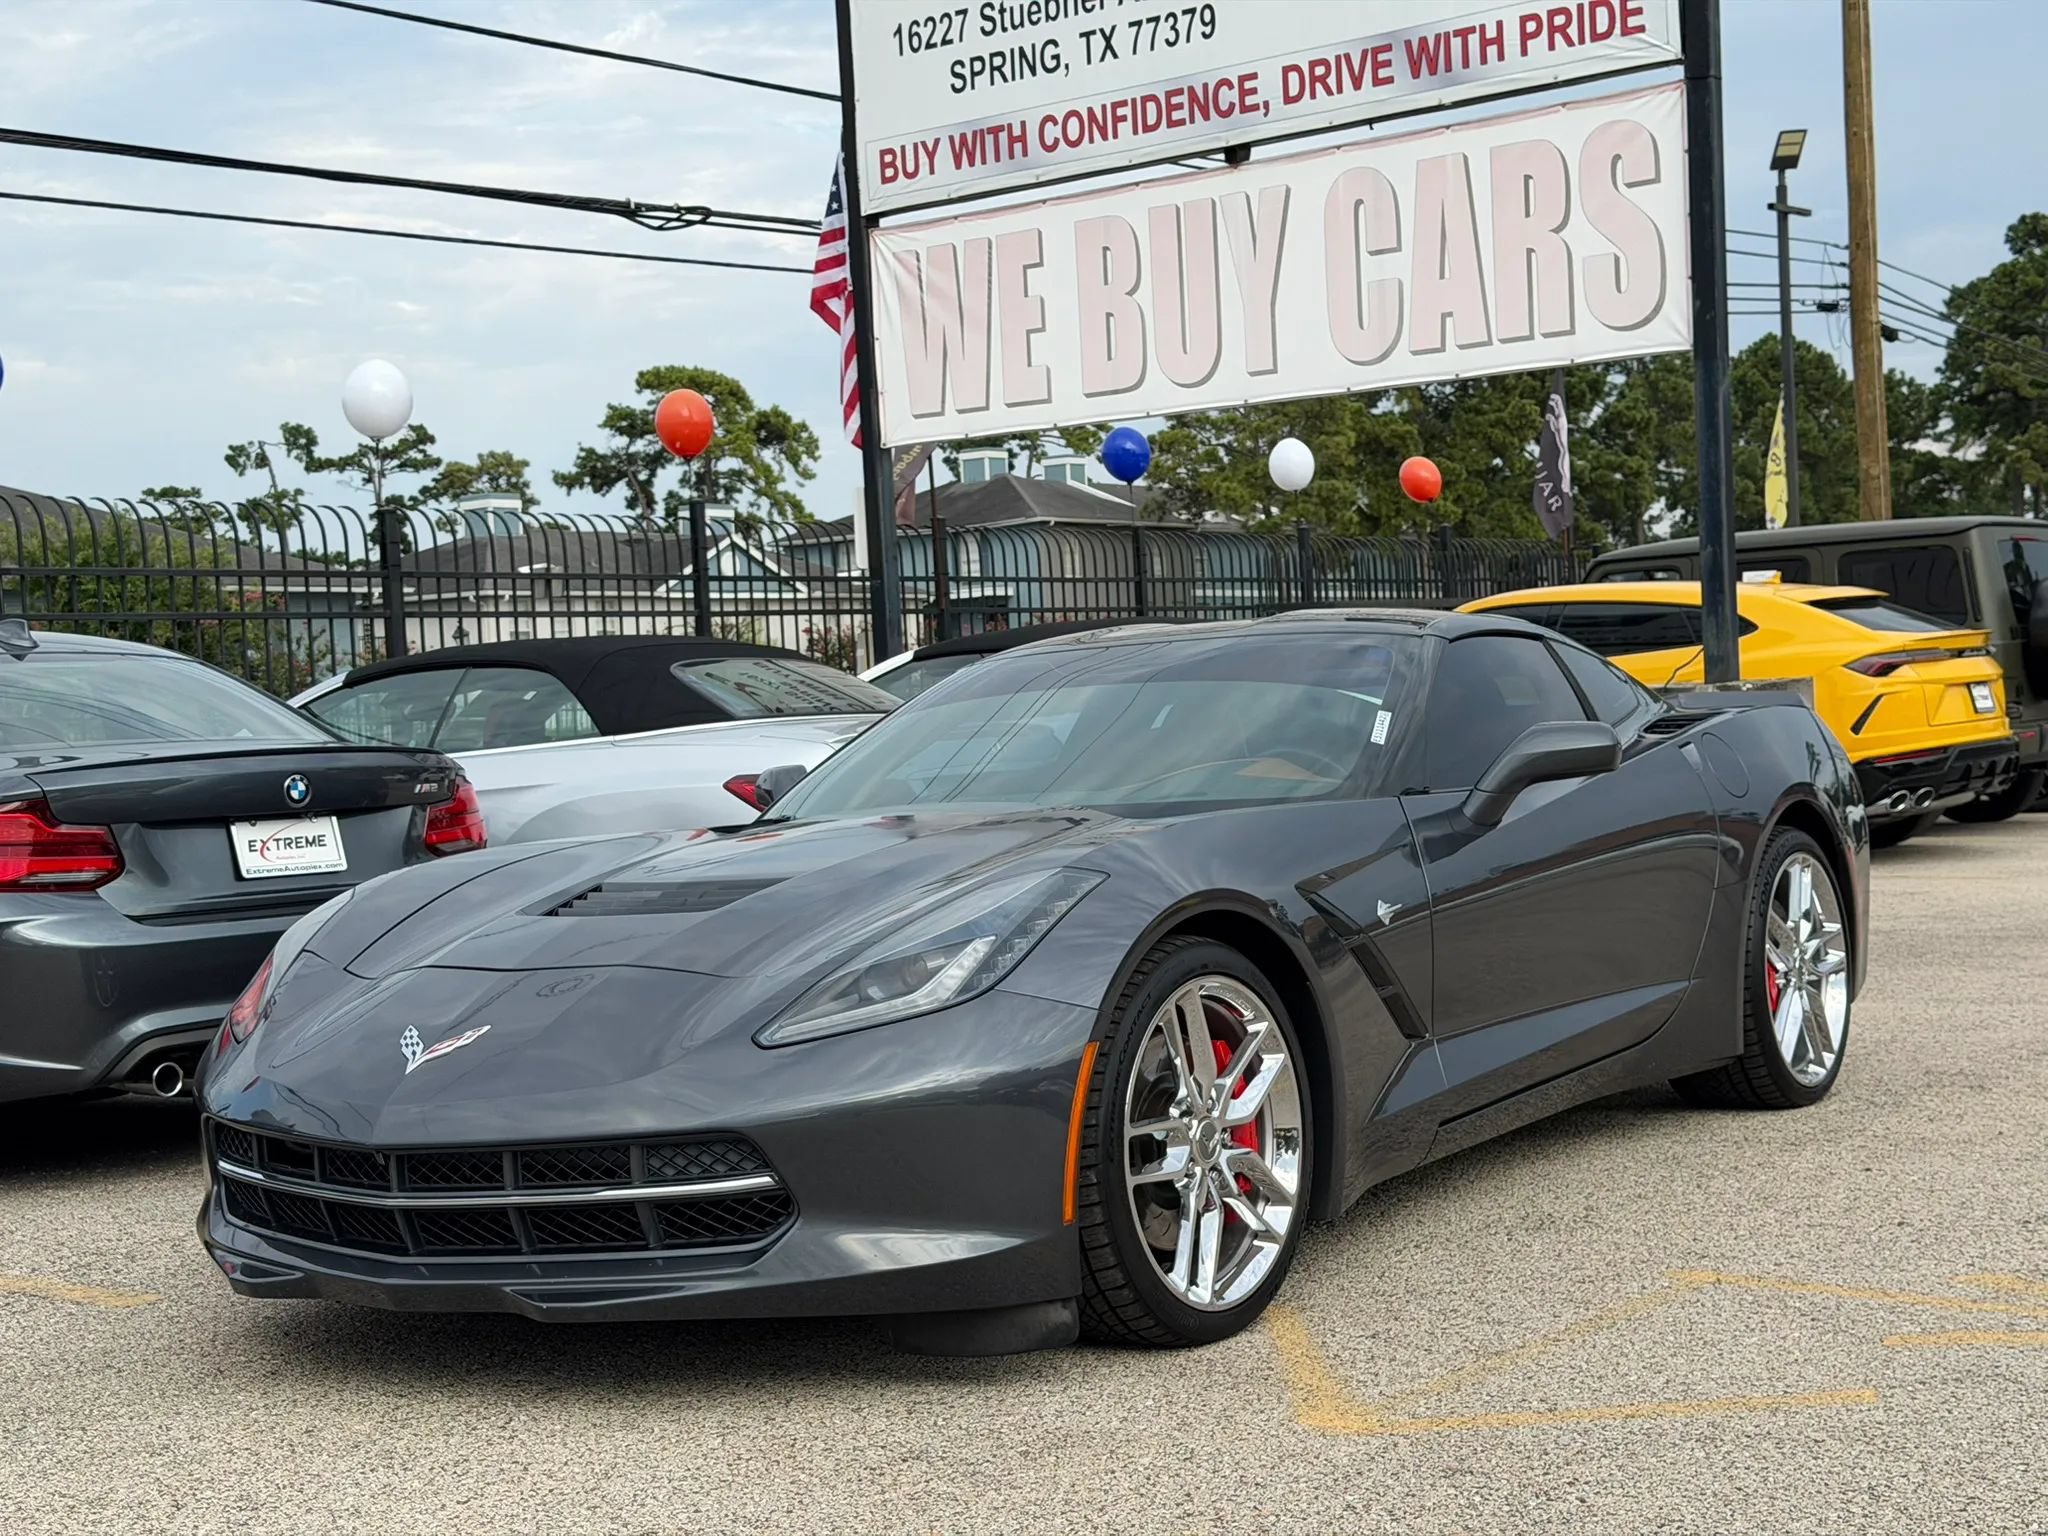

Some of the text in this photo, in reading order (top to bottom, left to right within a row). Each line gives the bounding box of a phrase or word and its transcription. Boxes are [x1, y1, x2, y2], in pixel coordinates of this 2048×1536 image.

[893, 9, 969, 57] 16227
[949, 4, 1217, 94] SPRING, TX 77379
[879, 0, 1646, 185] BUY WITH CONFIDENCE, DRIVE WITH PRIDE
[893, 119, 1666, 419] WE BUY CARS
[247, 834, 327, 853] EXTREME
